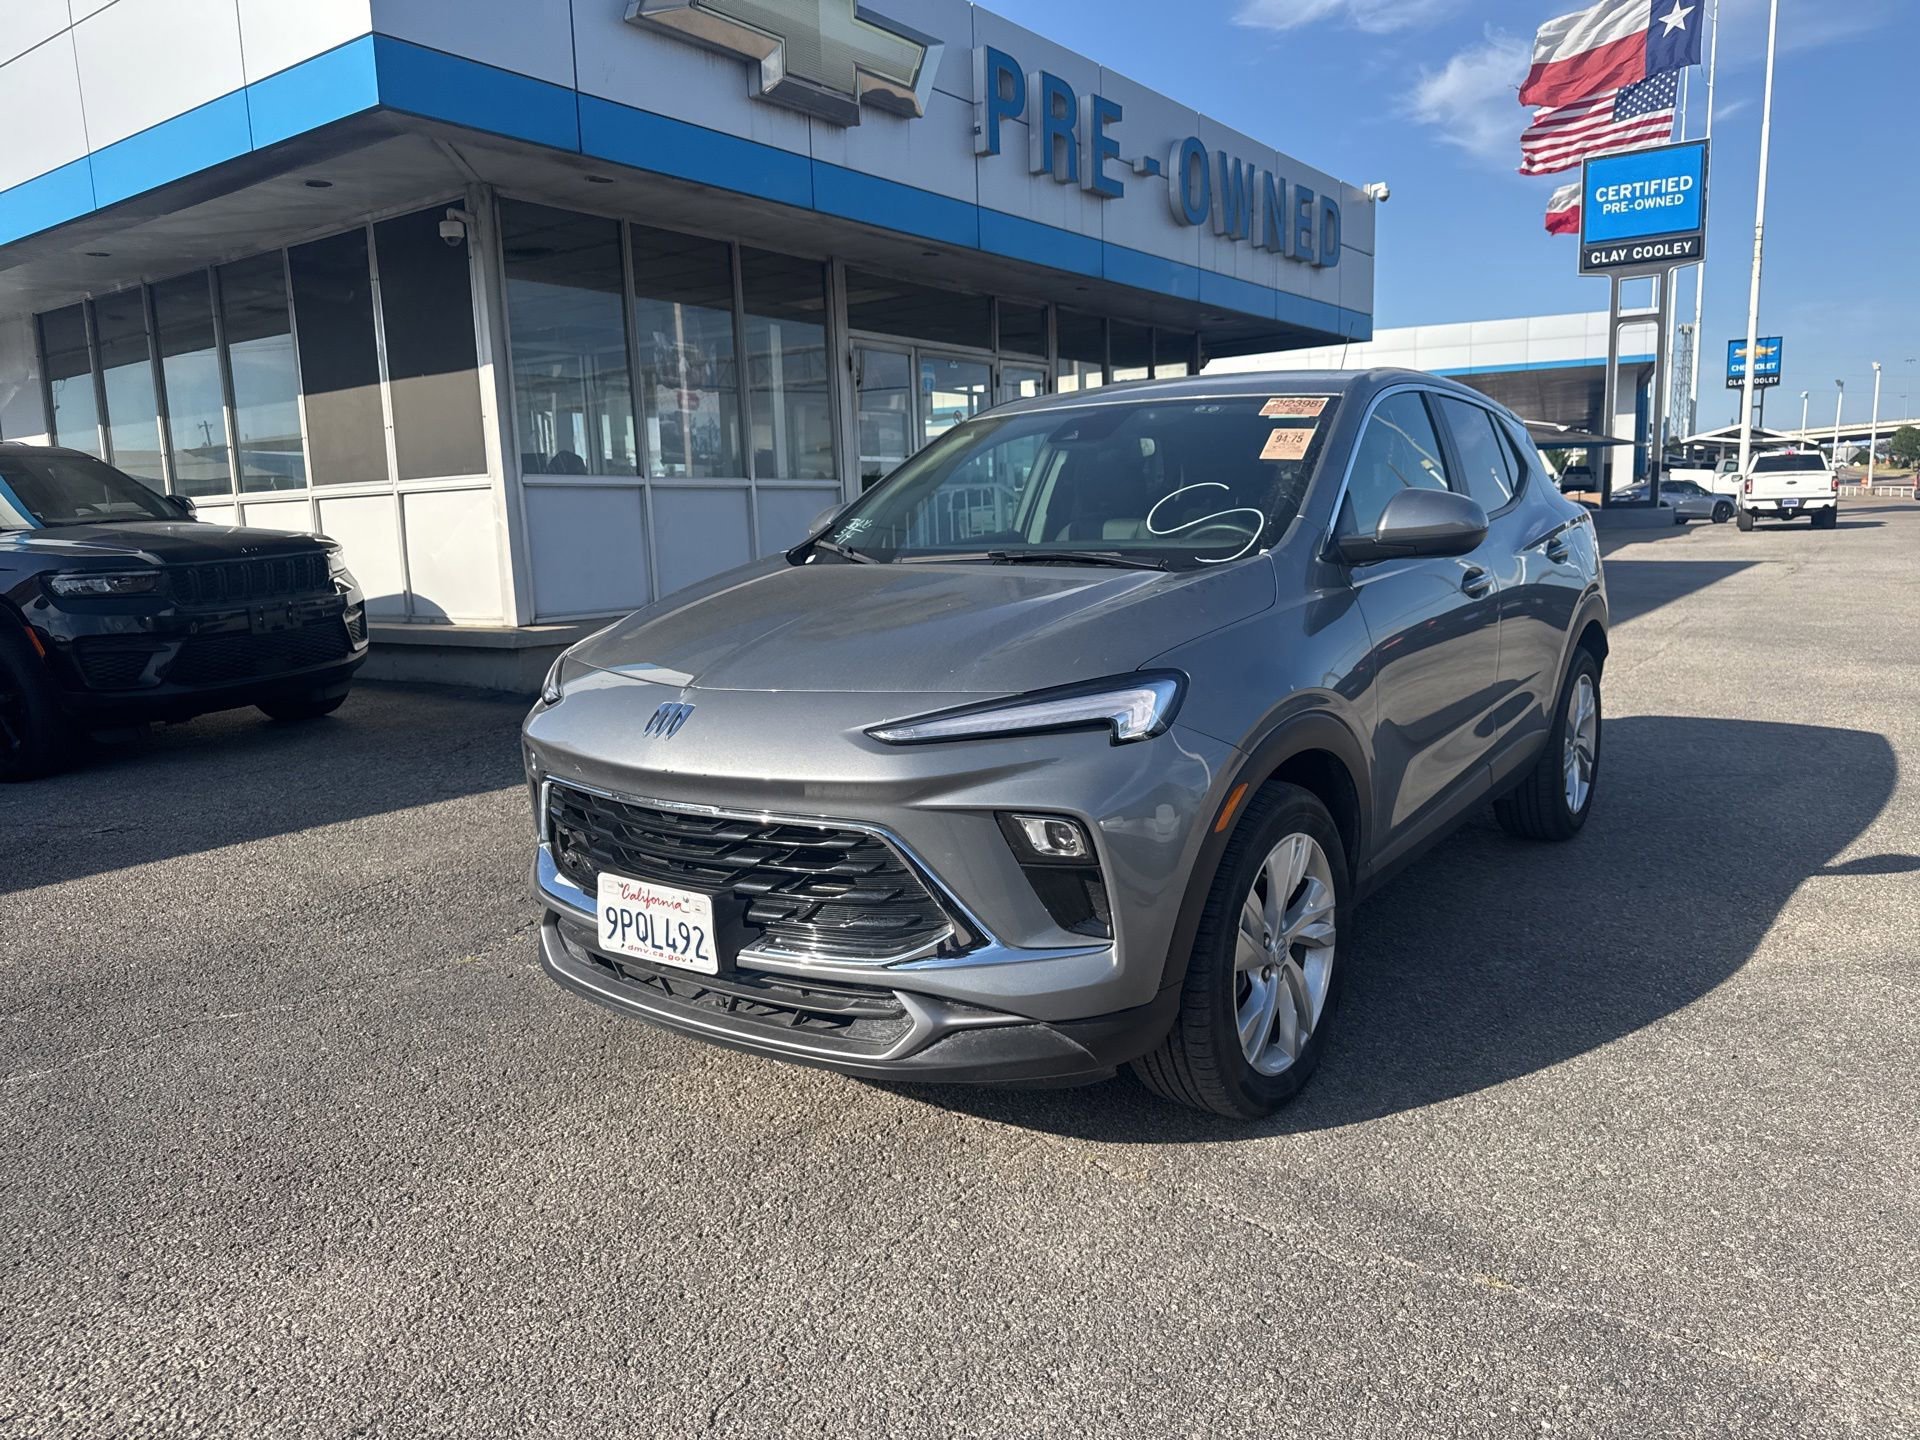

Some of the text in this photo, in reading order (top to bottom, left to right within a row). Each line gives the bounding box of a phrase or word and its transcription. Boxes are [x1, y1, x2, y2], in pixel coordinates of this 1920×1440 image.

[974, 45, 1341, 268] PRE-OWNED
[1596, 175, 1693, 202] CERTIFIED
[1602, 194, 1684, 215] PRE-OWNED
[1591, 241, 1692, 264] CLAY COOLEY
[622, 883, 690, 913] California
[606, 906, 709, 960] 9PQL492
[628, 944, 687, 963] dmv.ca.gov
